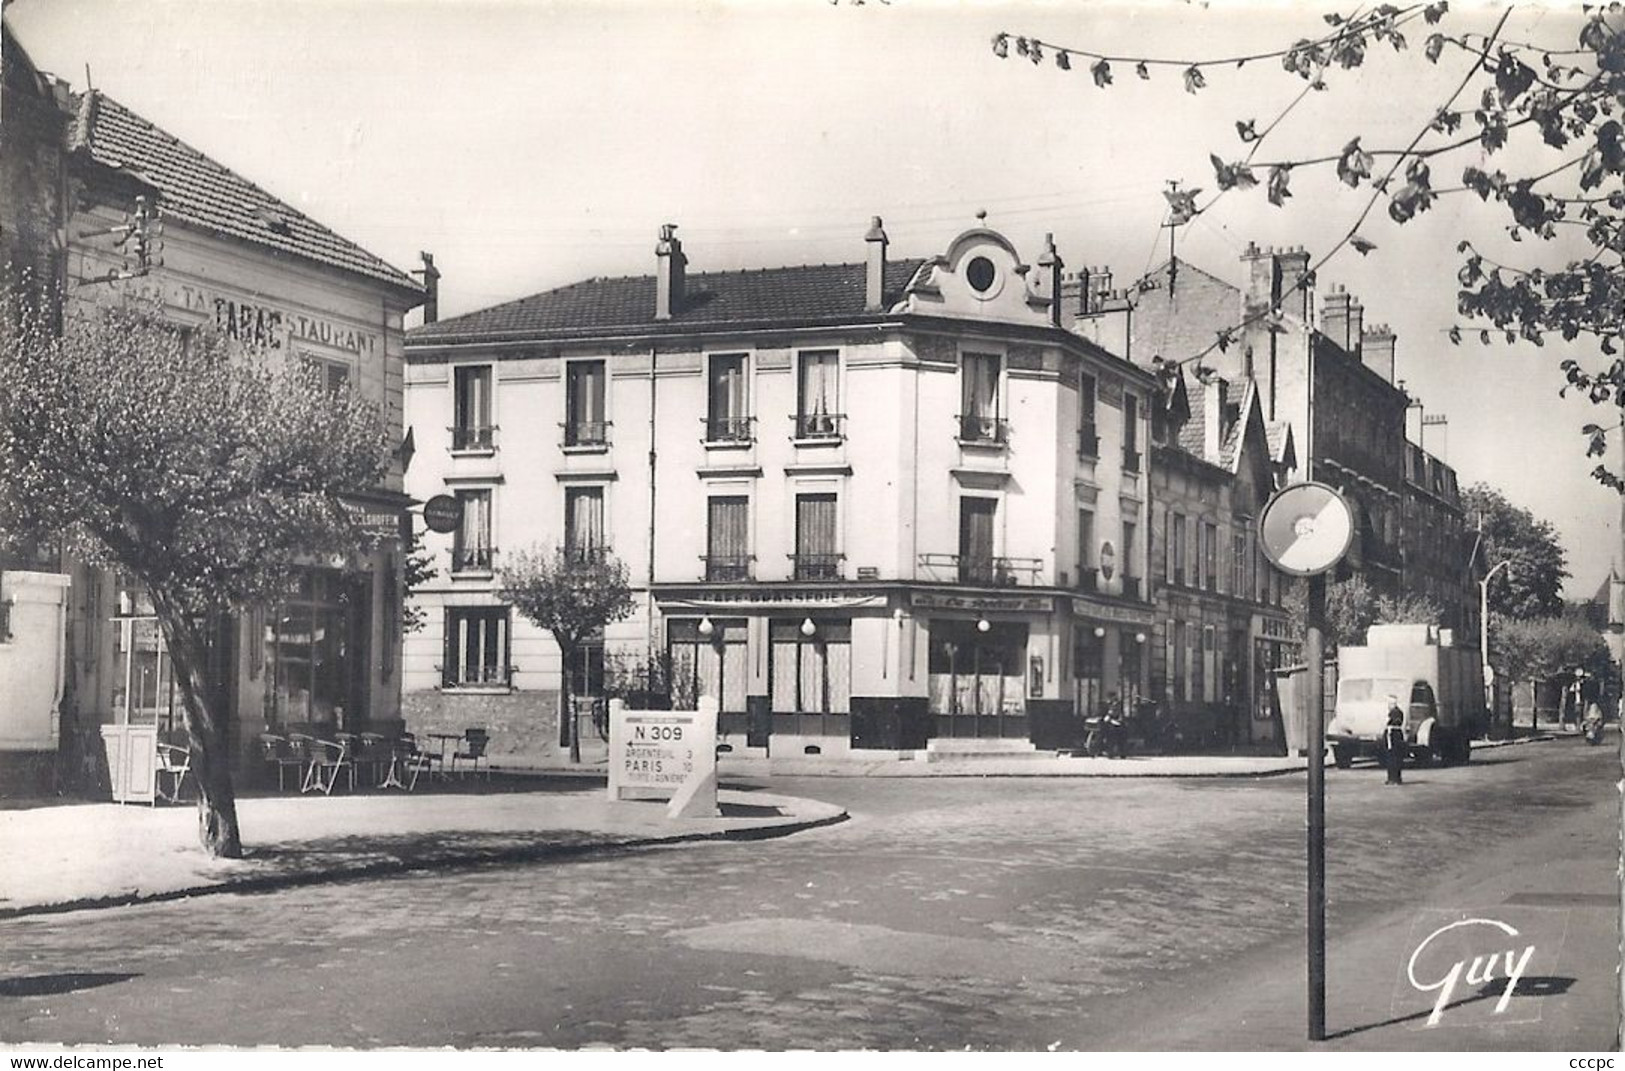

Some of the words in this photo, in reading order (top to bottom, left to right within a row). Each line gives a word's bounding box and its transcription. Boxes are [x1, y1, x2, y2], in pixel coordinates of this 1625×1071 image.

[213, 297, 282, 350] TABAC
[287, 312, 376, 353] STAURANT
[635, 726, 646, 740] N
[651, 726, 683, 741] 309
[686, 749, 693, 760] 3
[625, 760, 663, 773] PARIS
